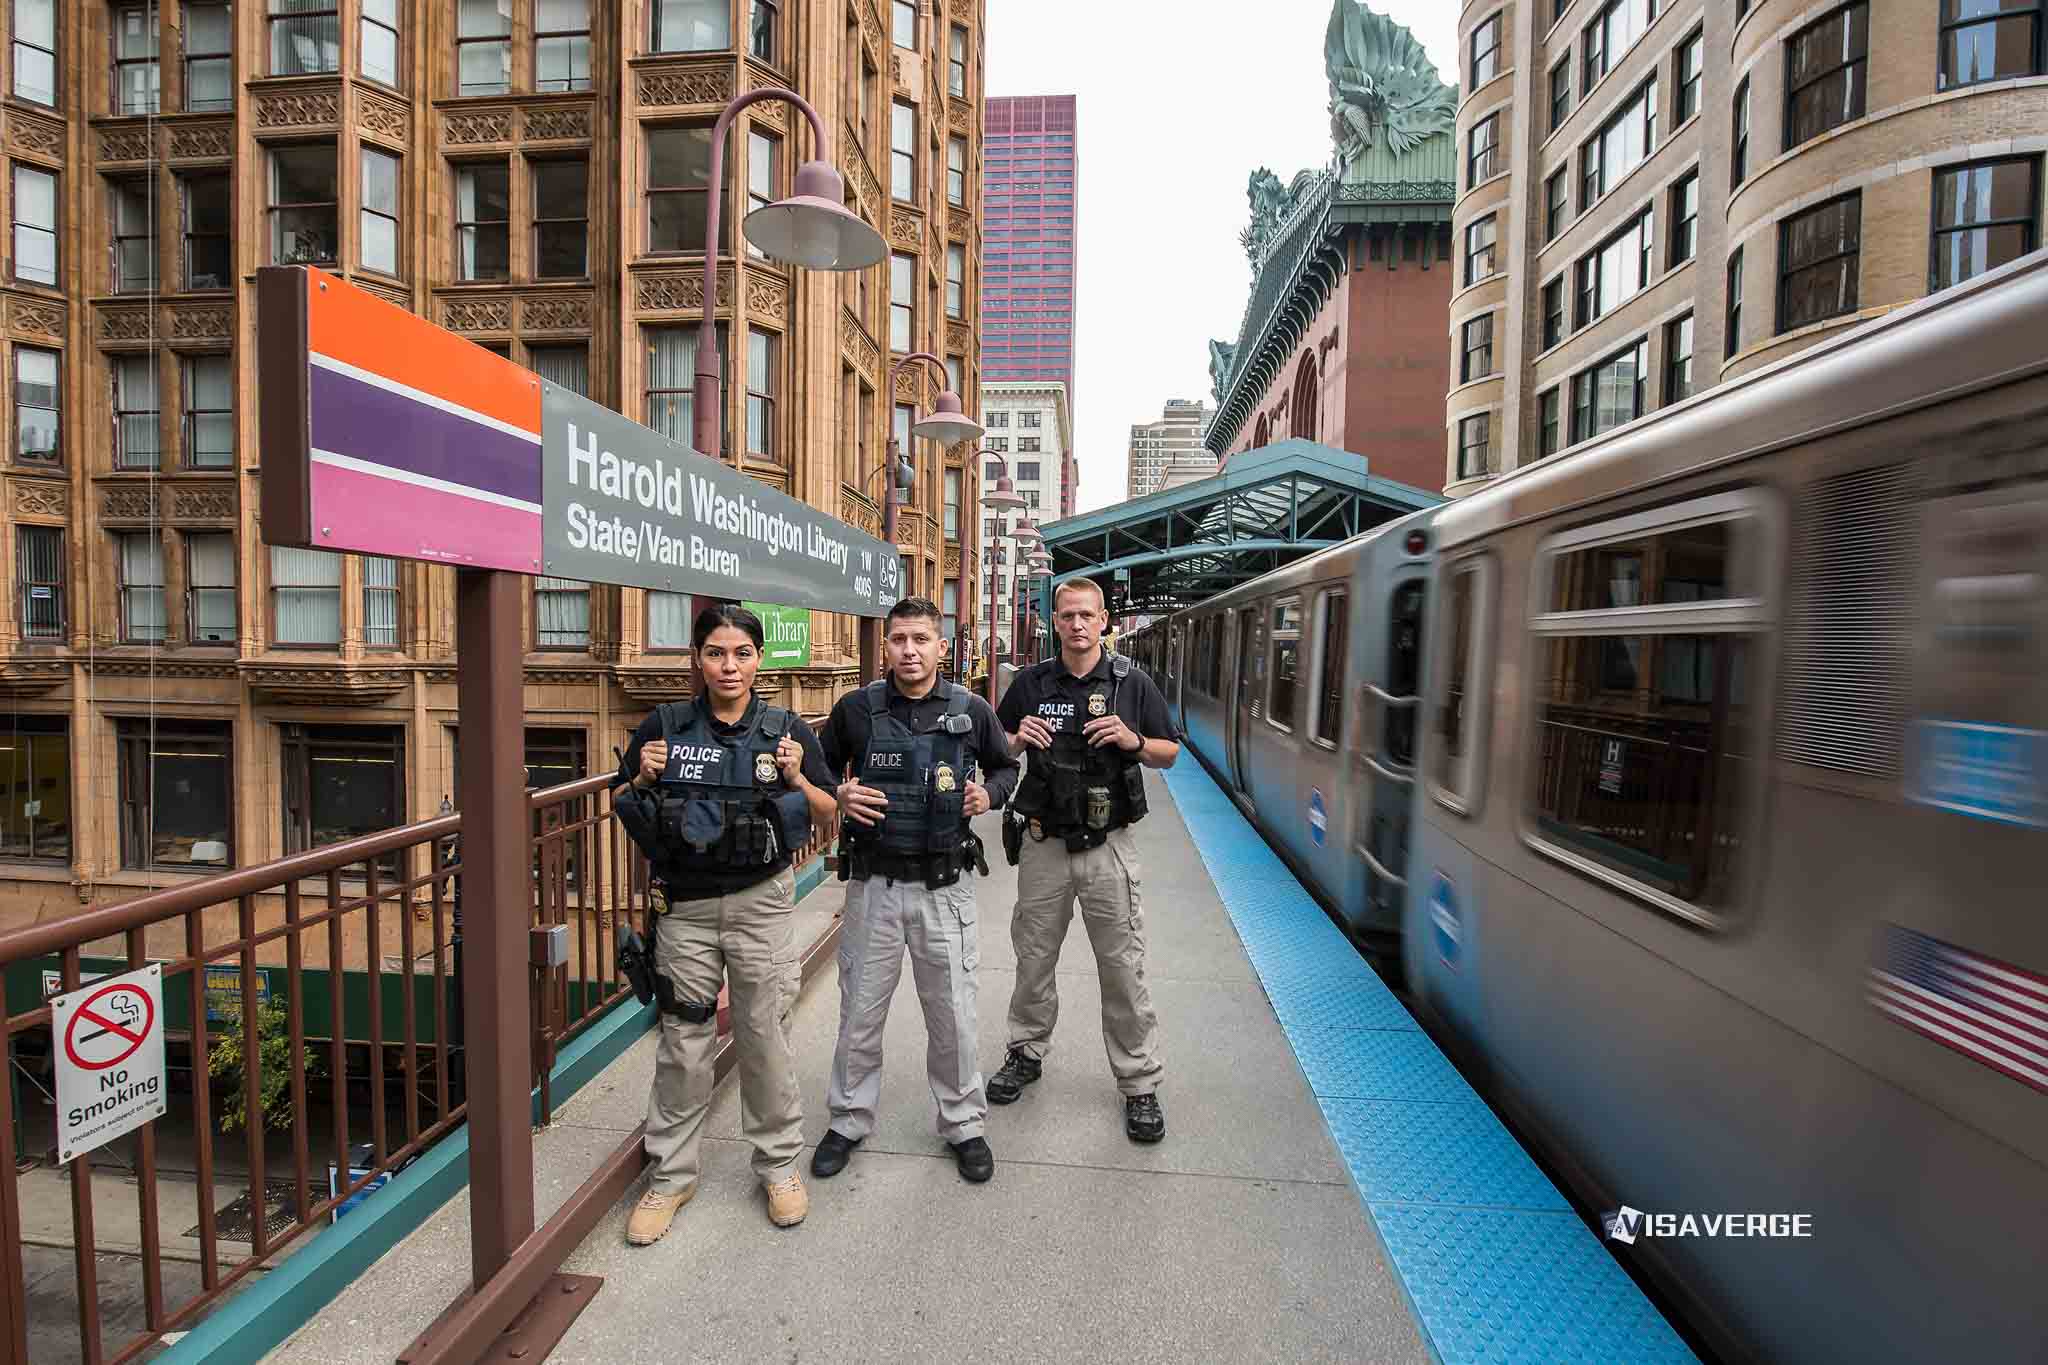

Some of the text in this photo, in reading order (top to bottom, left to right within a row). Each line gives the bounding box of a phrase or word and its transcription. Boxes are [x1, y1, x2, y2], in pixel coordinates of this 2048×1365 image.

[568, 423, 849, 574] Harold Washington Library
[568, 502, 740, 576] State/Van Buren
[861, 550, 872, 572] 1W
[854, 575, 872, 598] 400S
[762, 611, 809, 649] Library
[1038, 703, 1075, 716] POLICE
[671, 745, 722, 763] POLICE
[871, 753, 902, 767] POLICE
[679, 763, 704, 779] ICE
[100, 1070, 128, 1092] No
[68, 1075, 158, 1127] Smoking
